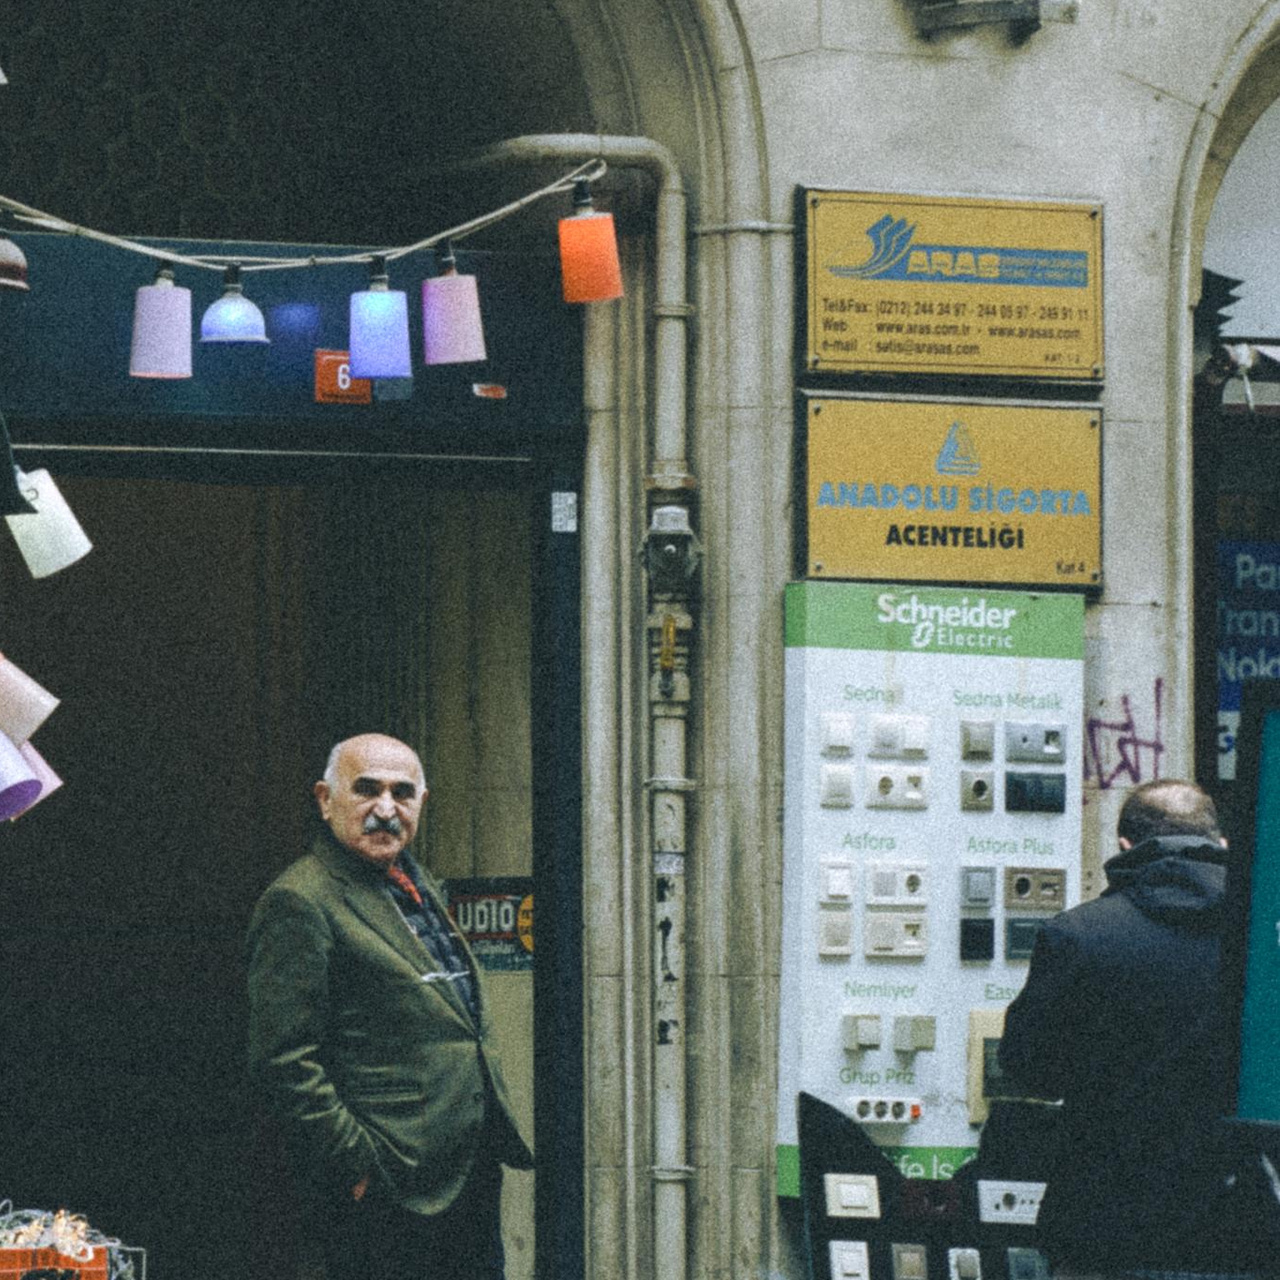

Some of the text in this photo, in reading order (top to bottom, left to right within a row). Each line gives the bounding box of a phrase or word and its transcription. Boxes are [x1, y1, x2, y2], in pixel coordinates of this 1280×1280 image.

[907, 250, 1000, 278] ARAS
[337, 363, 352, 390] 6
[816, 480, 1091, 517] ANADOLU SİGORTA
[1235, 552, 1280, 589] Pa
[877, 593, 1017, 629] Schneider
[937, 626, 1014, 649] Electric
[843, 684, 896, 704] Sedna
[953, 689, 1063, 711] Sedna Metalik
[842, 832, 896, 851] Asfora
[967, 835, 1054, 855] Asfora Plus
[457, 901, 515, 932] UDIO
[839, 1067, 915, 1086] Grup Priz
